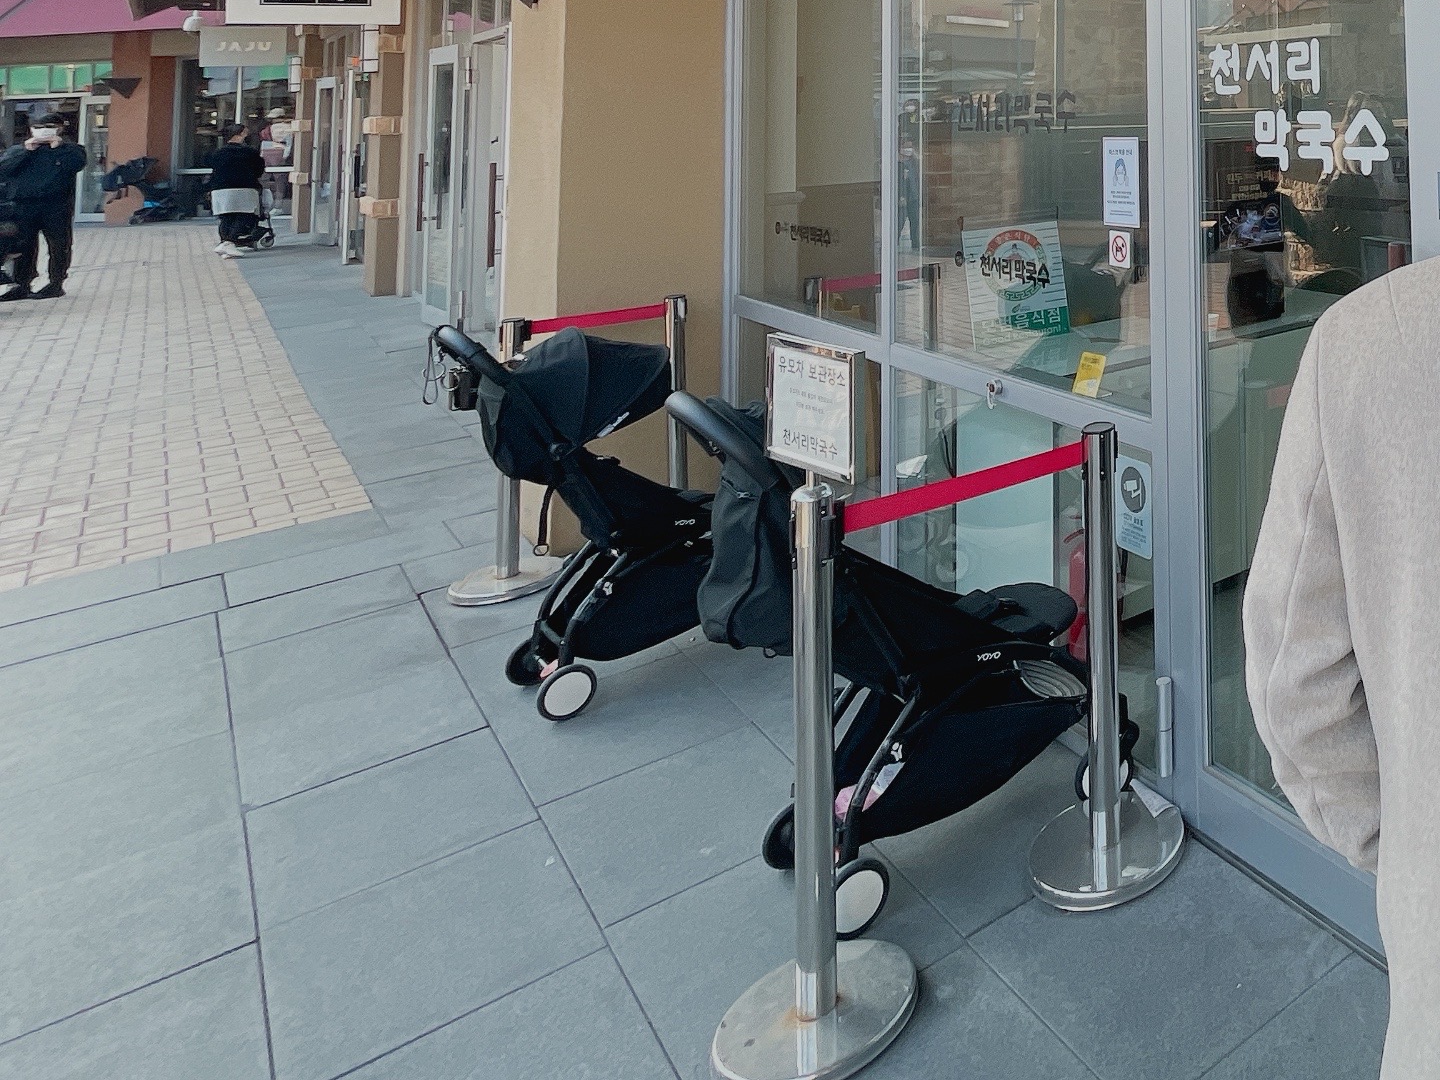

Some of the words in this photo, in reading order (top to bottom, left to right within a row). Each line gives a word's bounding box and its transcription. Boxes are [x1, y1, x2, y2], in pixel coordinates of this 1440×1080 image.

[216, 41, 273, 52] JAJU
[1208, 37, 1322, 96] 천서리
[1254, 108, 1391, 176] 막국수
[979, 253, 1051, 289] 천서리막국수
[778, 356, 805, 379] 유모차
[808, 363, 846, 387] 보관장소
[782, 428, 838, 461] 천서리막국수
[976, 651, 1002, 663] YOYO
